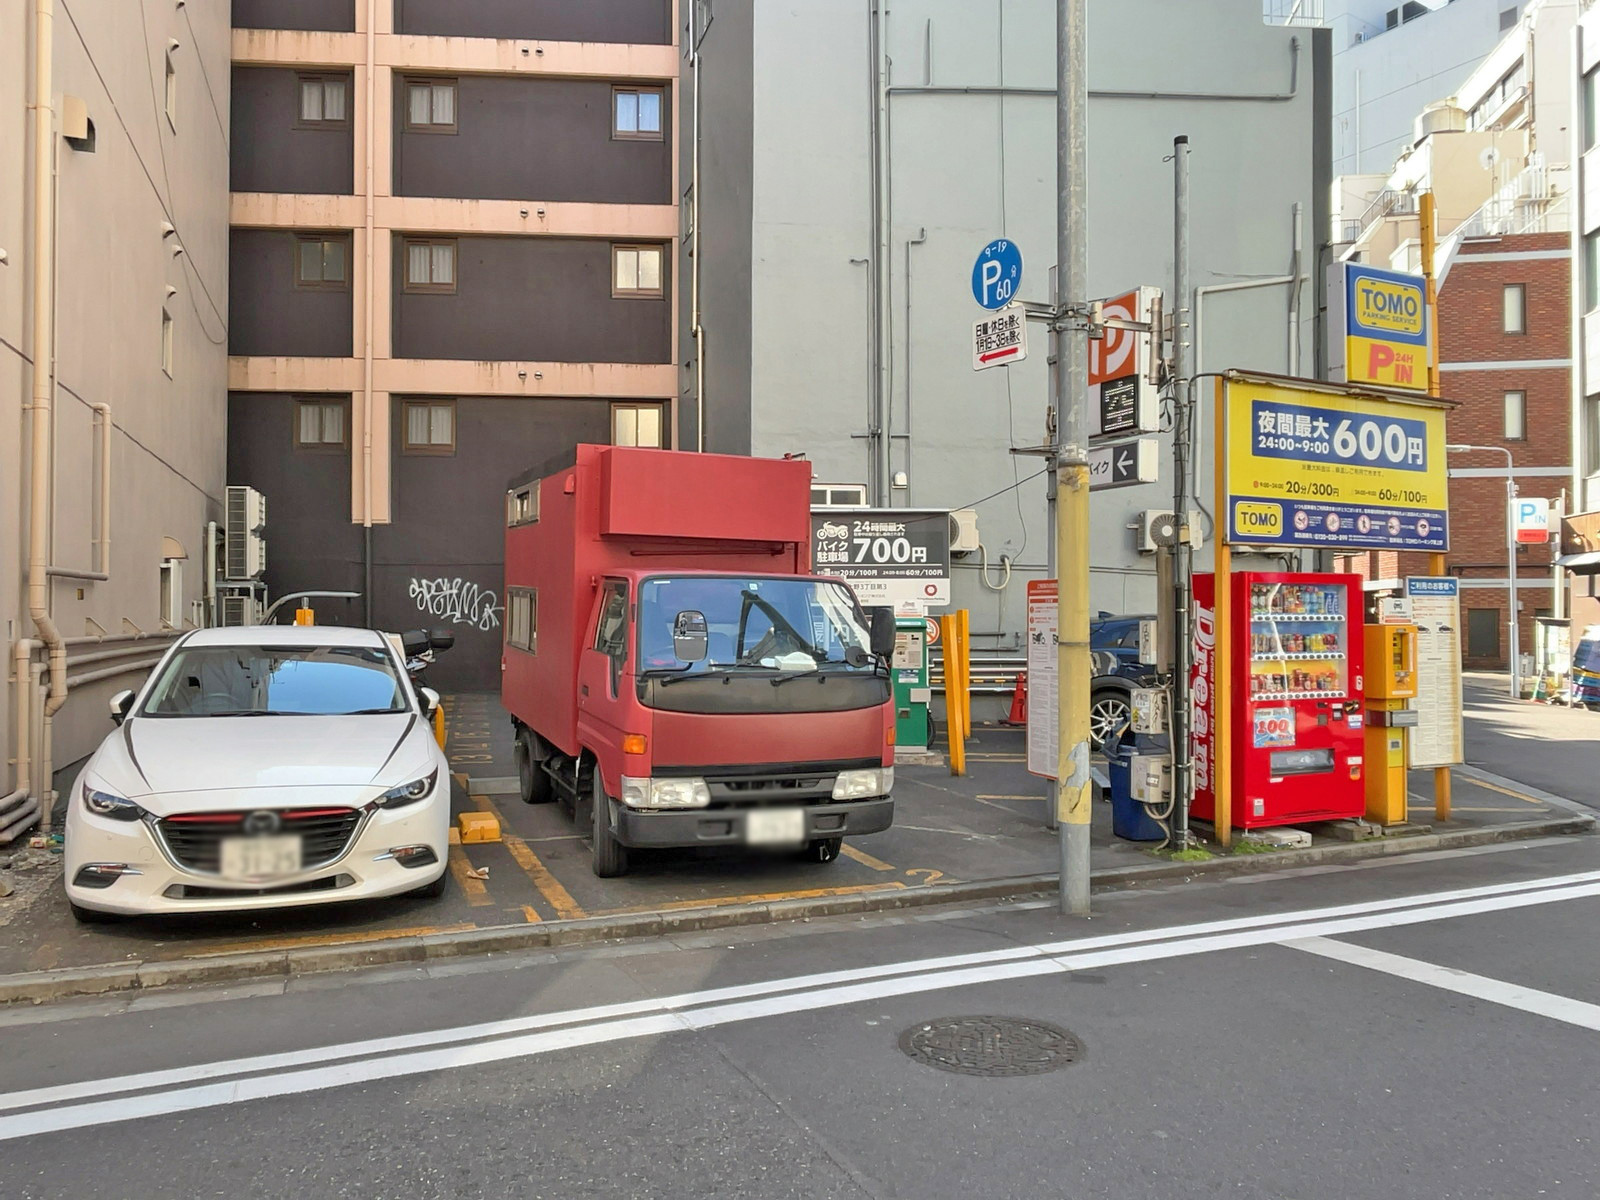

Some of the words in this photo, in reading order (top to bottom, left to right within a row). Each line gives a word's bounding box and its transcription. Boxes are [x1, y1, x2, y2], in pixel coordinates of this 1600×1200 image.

[982, 260, 1001, 306] P
[996, 279, 1011, 300] 60
[1362, 288, 1417, 317] TOMO
[1363, 311, 1390, 321] PARKING
[1392, 316, 1417, 326] SERVICE
[1368, 343, 1395, 380] P
[1395, 353, 1414, 364] 24H
[1394, 363, 1414, 384] IN
[1258, 410, 1330, 440] 夜間最大
[1333, 419, 1424, 465] 600円
[1285, 481, 1340, 497] 20分/300円
[1378, 489, 1428, 503] 60分/100円
[1240, 512, 1278, 526] TOMO
[1520, 503, 1536, 523] P
[817, 541, 848, 551] バイク
[853, 537, 927, 563] 700円
[817, 551, 849, 563] 駐車場
[1193, 599, 1217, 793] Dream
